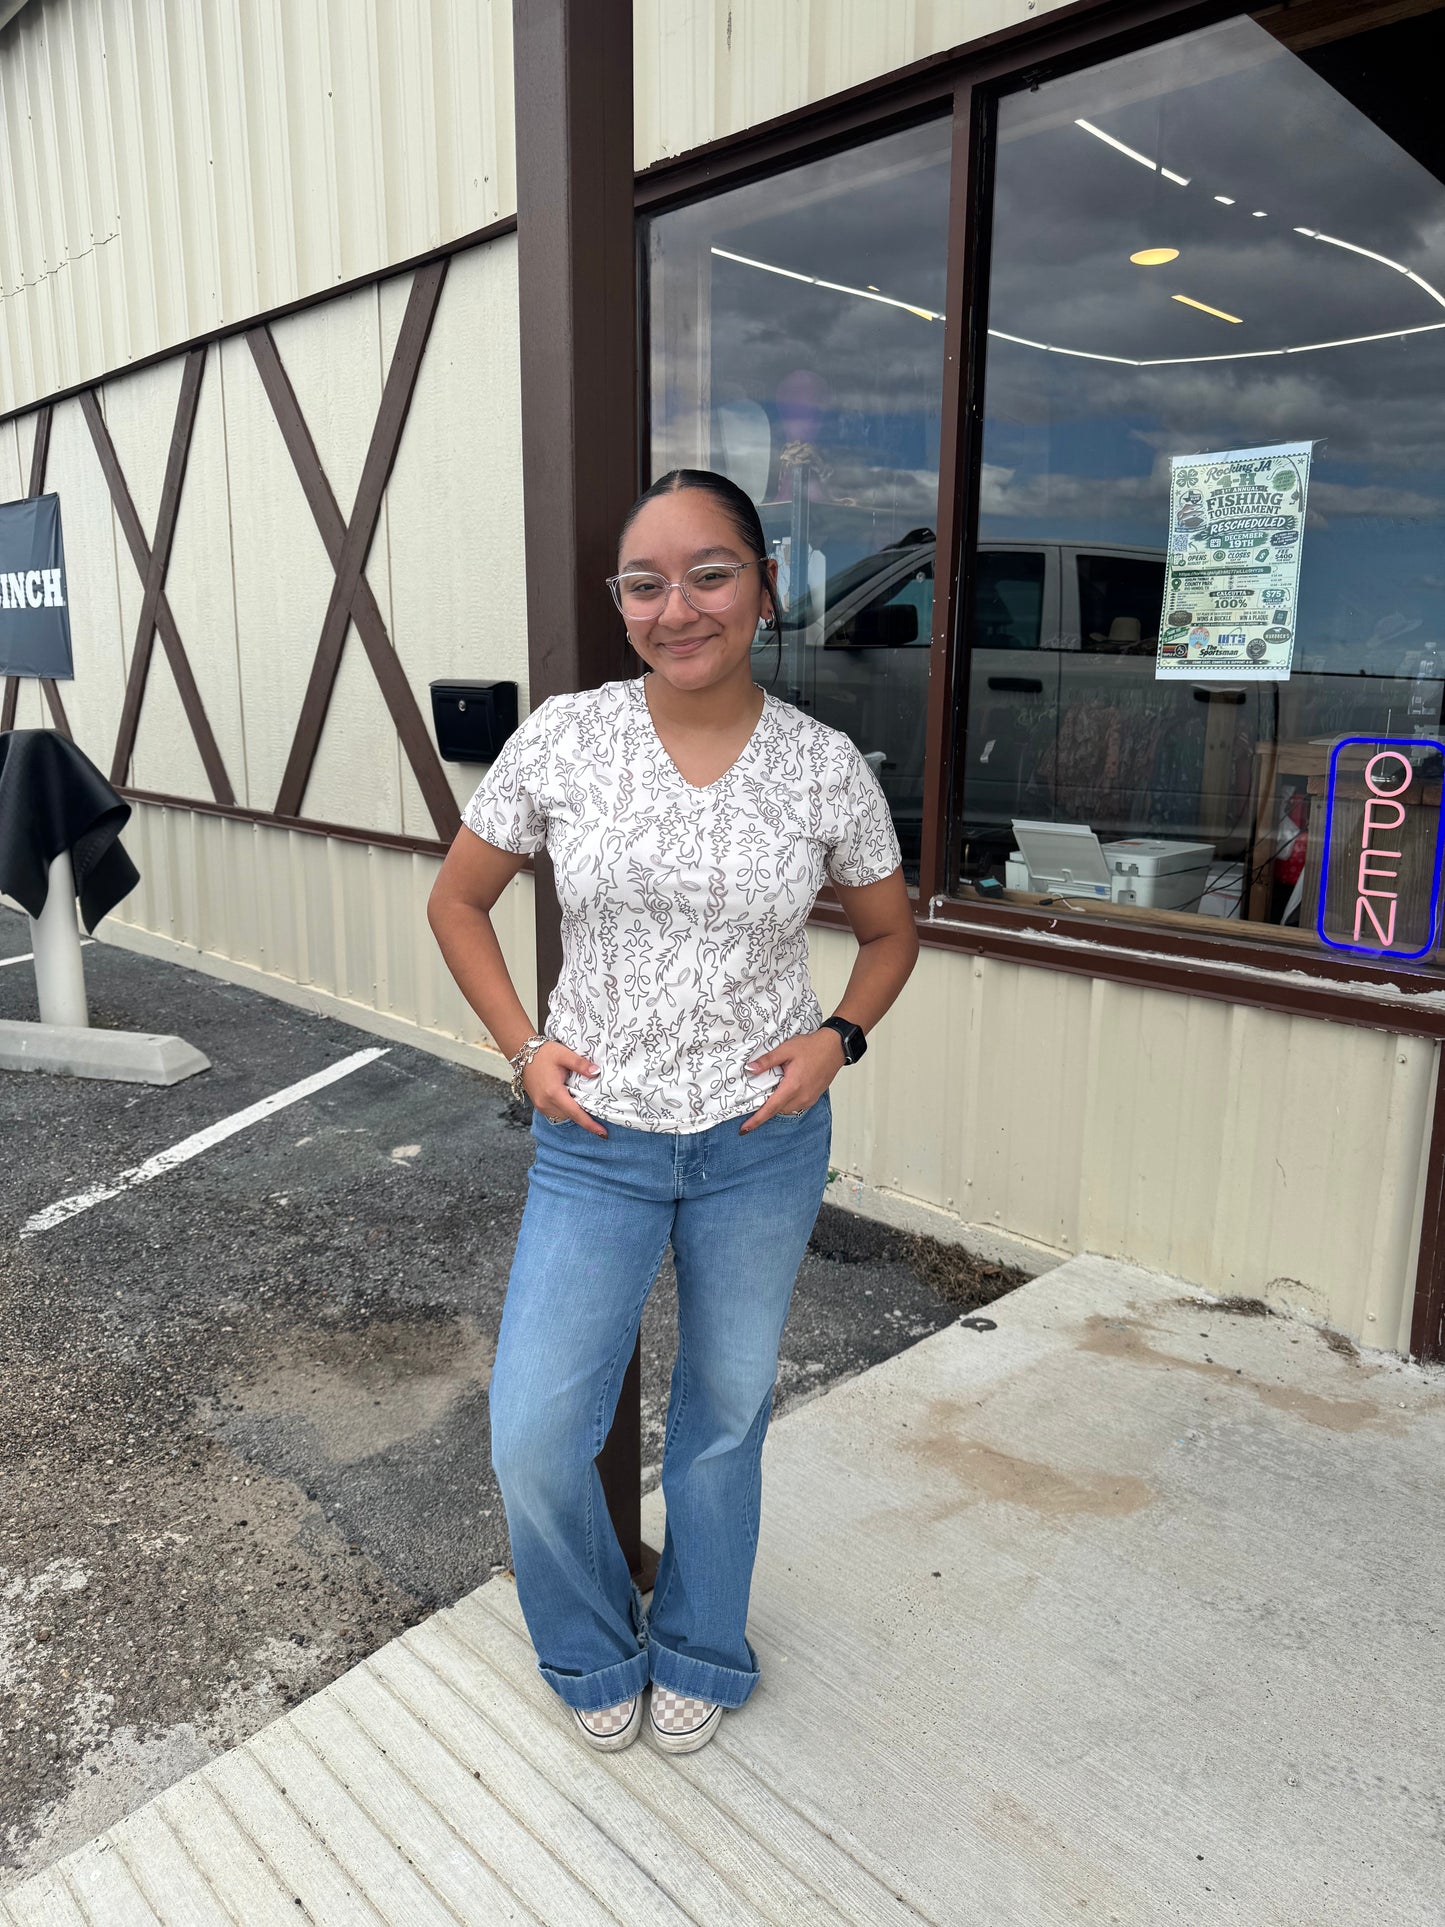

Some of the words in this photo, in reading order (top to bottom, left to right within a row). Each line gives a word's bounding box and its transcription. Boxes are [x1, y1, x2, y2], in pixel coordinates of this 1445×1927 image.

[1204, 463, 1254, 483] Rocking
[1254, 460, 1272, 472] JA
[1217, 473, 1256, 488] 4-H
[1233, 485, 1259, 493] ANNUAL
[1206, 492, 1283, 510] FISHING
[1208, 505, 1281, 519] TOURNAMENT
[1210, 517, 1286, 535] RESCHEDULED
[1224, 532, 1264, 541] DECEMBER
[1229, 540, 1254, 548] 19TH
[0, 568, 62, 609] INCH
[1265, 590, 1282, 598] $75
[1214, 599, 1248, 609] 100%
[1198, 649, 1239, 657] Sportsman
[1353, 751, 1413, 946] OPEN
